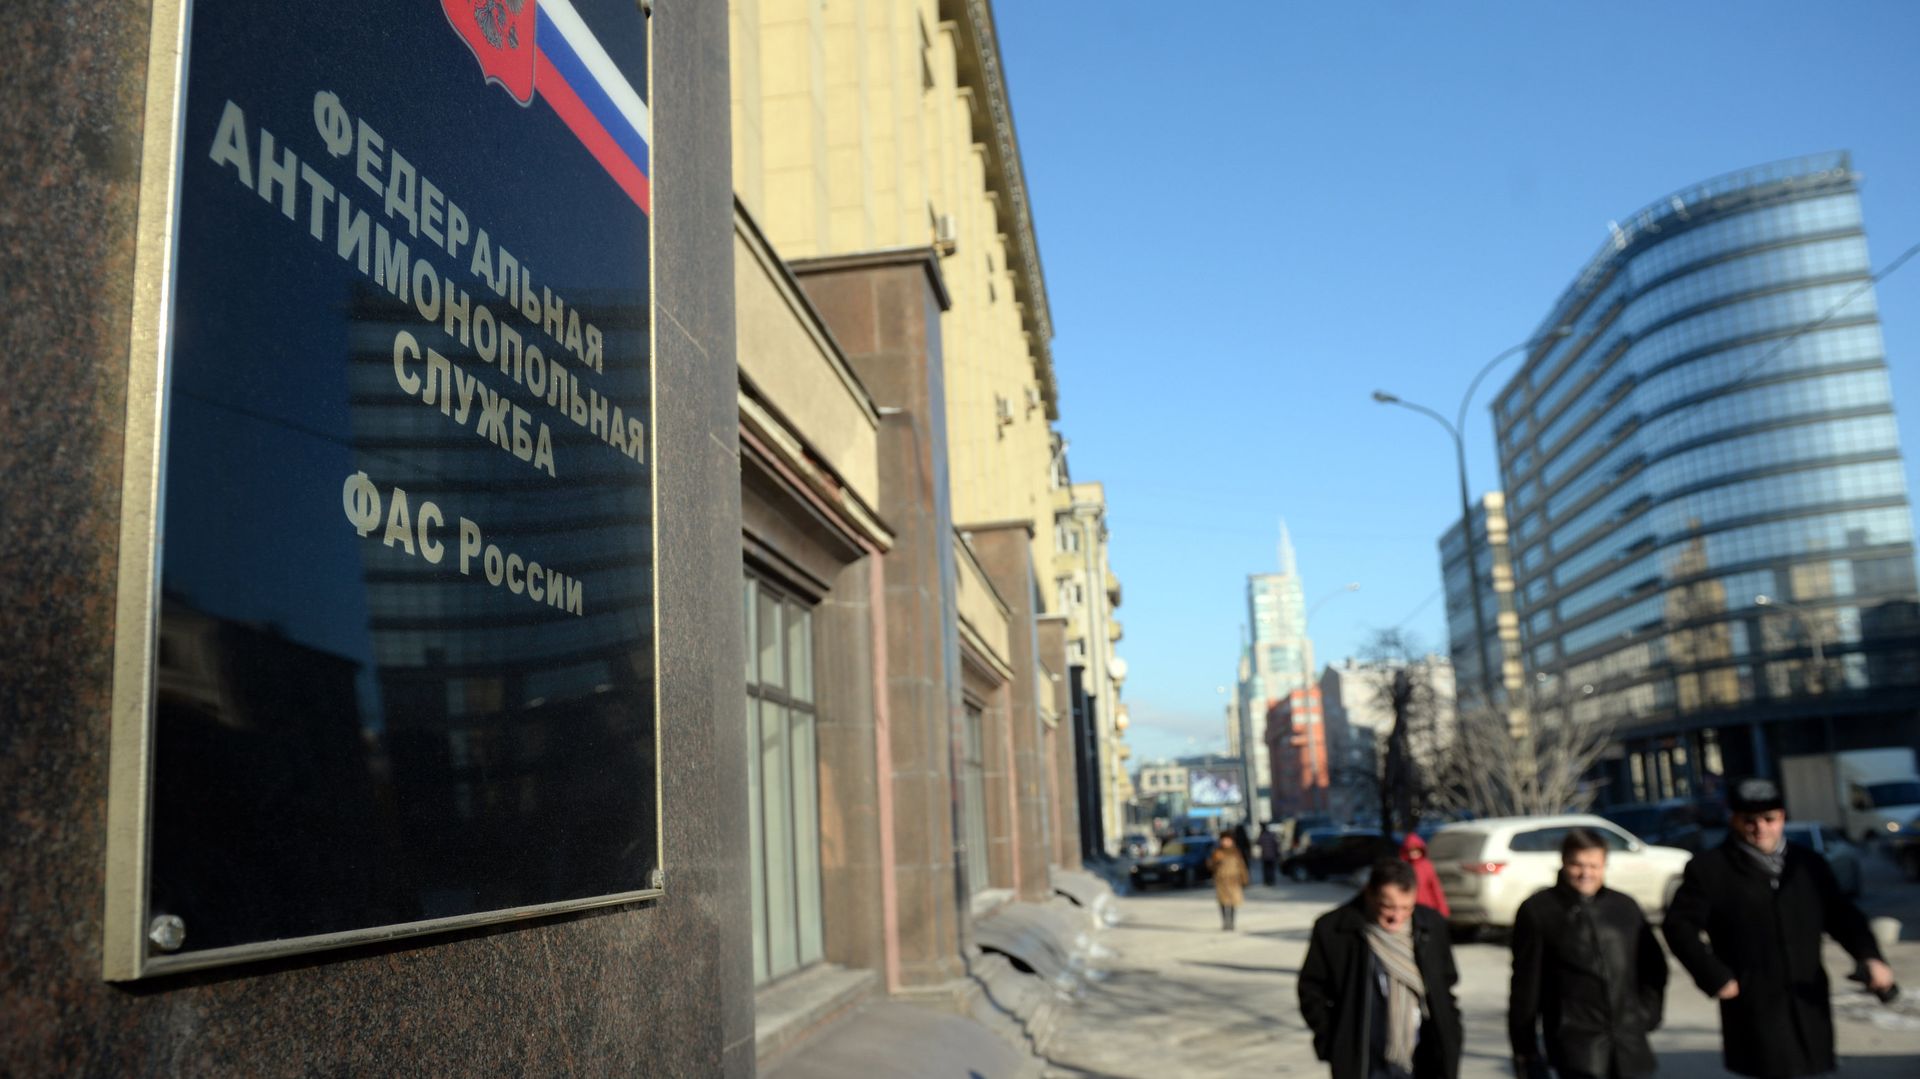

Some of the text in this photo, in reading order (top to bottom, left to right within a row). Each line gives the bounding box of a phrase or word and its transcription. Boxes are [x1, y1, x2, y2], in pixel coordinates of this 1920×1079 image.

[209, 100, 644, 464] АНТИМОНОПОЛЬНАЯ
[314, 90, 602, 374] ФЕДЕРАЛЬНАЯ
[393, 330, 556, 478] СЛУЖБА
[342, 470, 445, 564] ФАС
